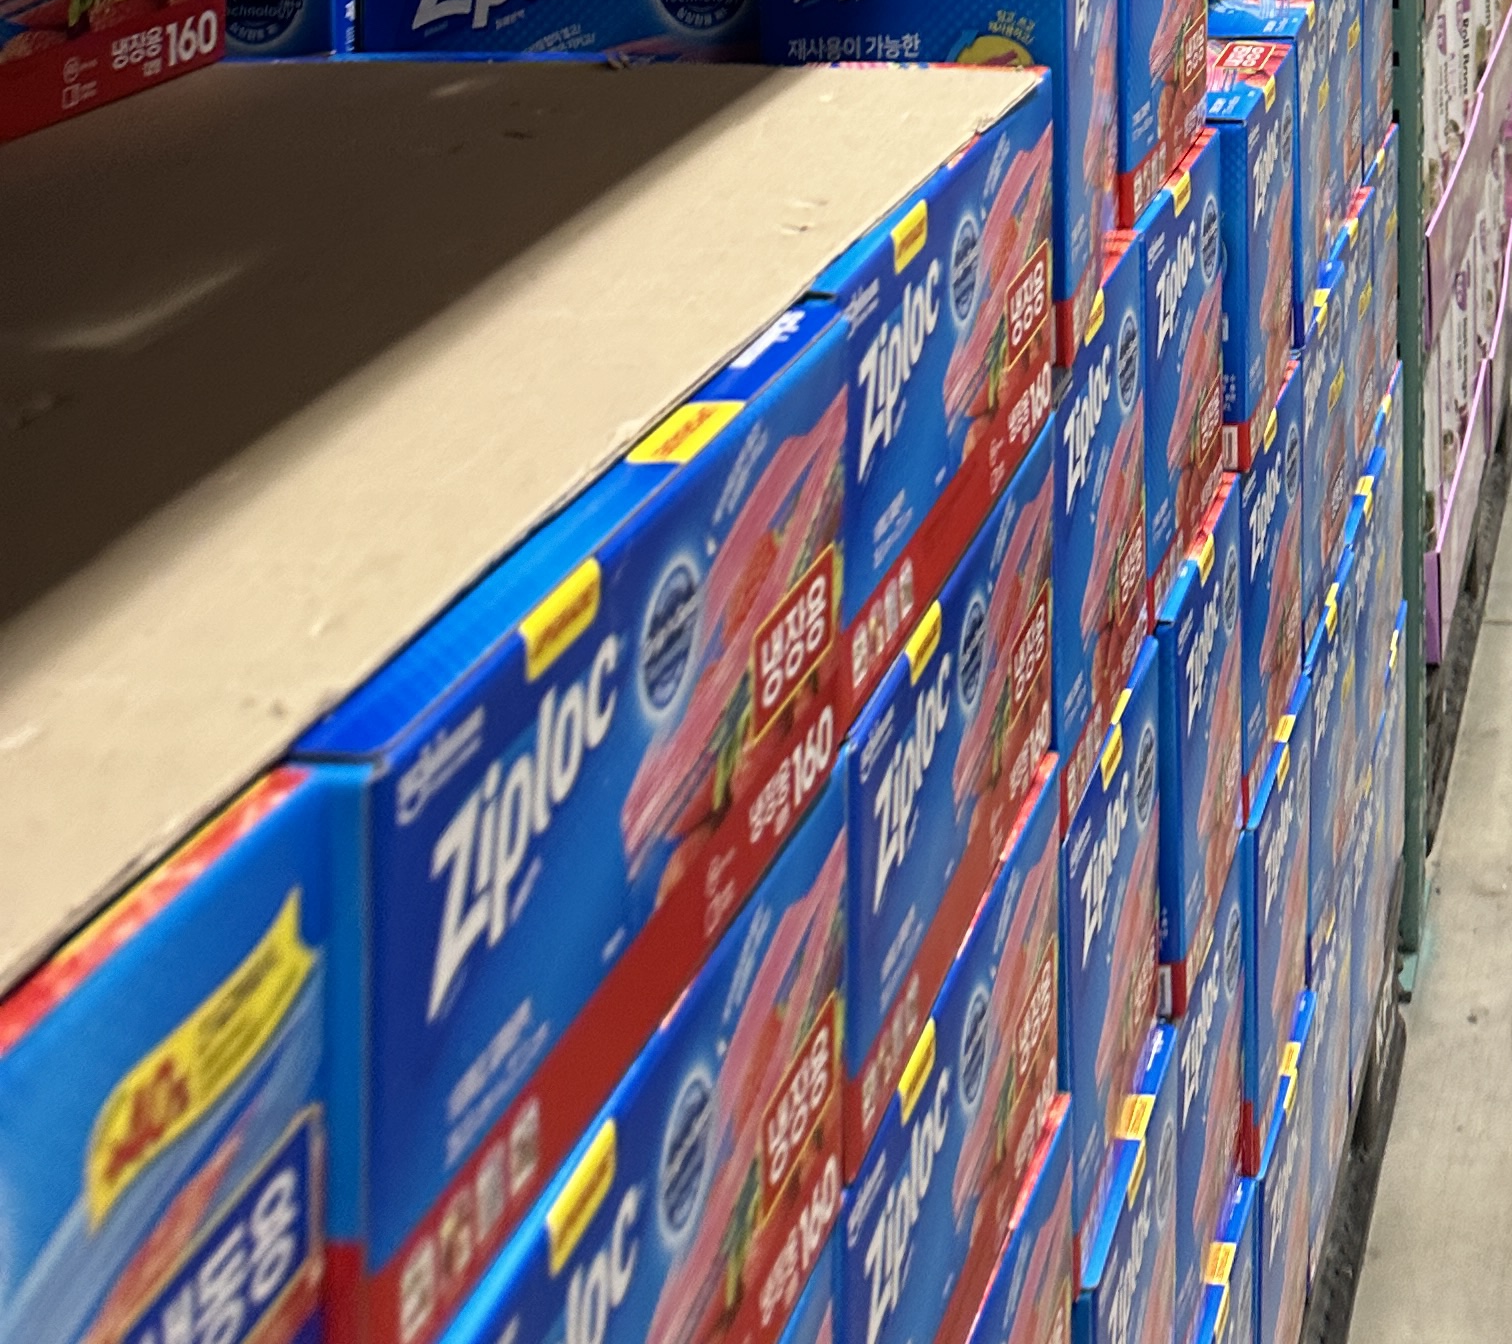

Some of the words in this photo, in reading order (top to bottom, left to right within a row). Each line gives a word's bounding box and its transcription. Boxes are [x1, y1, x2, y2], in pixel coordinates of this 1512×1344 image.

[112, 27, 164, 71] 냉장용
[166, 9, 217, 66] 160
[787, 36, 862, 62] 재사용이
[865, 32, 921, 59] 가능한
[1252, 119, 1280, 232] Ziploc
[1010, 258, 1045, 346] 냉장용
[1155, 219, 1197, 360] Ziploc
[857, 257, 941, 484] Ziploc
[1030, 360, 1053, 432] 160
[1063, 343, 1112, 516] Ziploc
[1249, 450, 1282, 583] Ziploc
[760, 573, 828, 710] 냉장용
[790, 704, 834, 809] 160
[873, 651, 951, 915] Ziploc
[425, 633, 620, 1024] Ziploc
[1081, 770, 1130, 972] Ziploc
[767, 1024, 830, 1187] 냉장용
[564, 1183, 644, 1344] loc
[799, 1152, 840, 1271] 160
[864, 1066, 951, 1344] Ziploc
